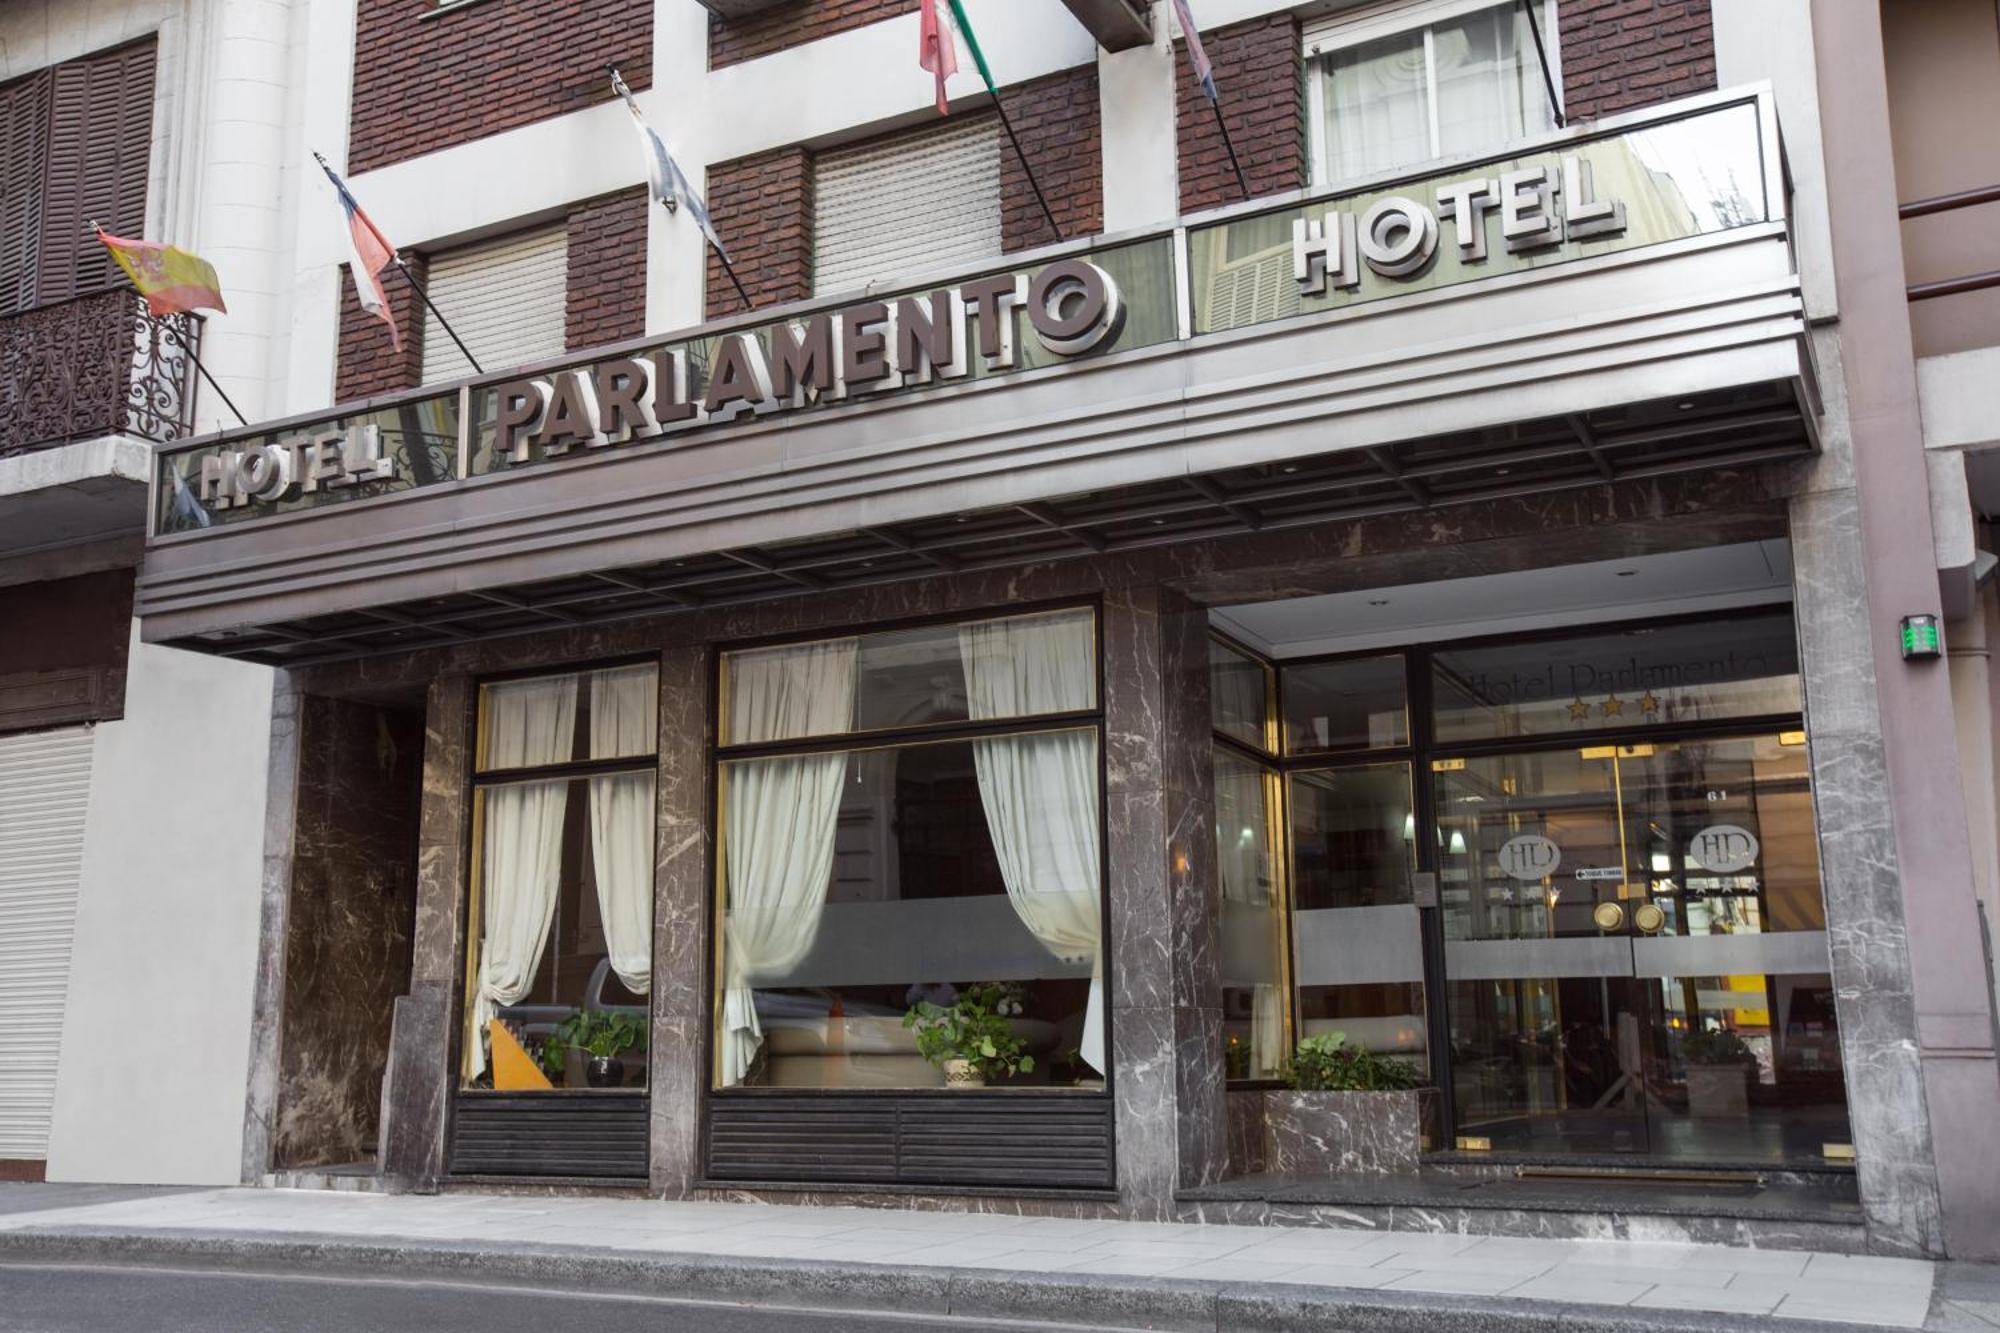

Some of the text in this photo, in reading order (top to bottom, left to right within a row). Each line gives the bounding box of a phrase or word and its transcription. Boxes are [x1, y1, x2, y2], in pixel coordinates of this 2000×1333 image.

[200, 154, 1626, 509] HOTEL PARLAMENTO HOTEL
[1471, 664, 1555, 702] Hotel
